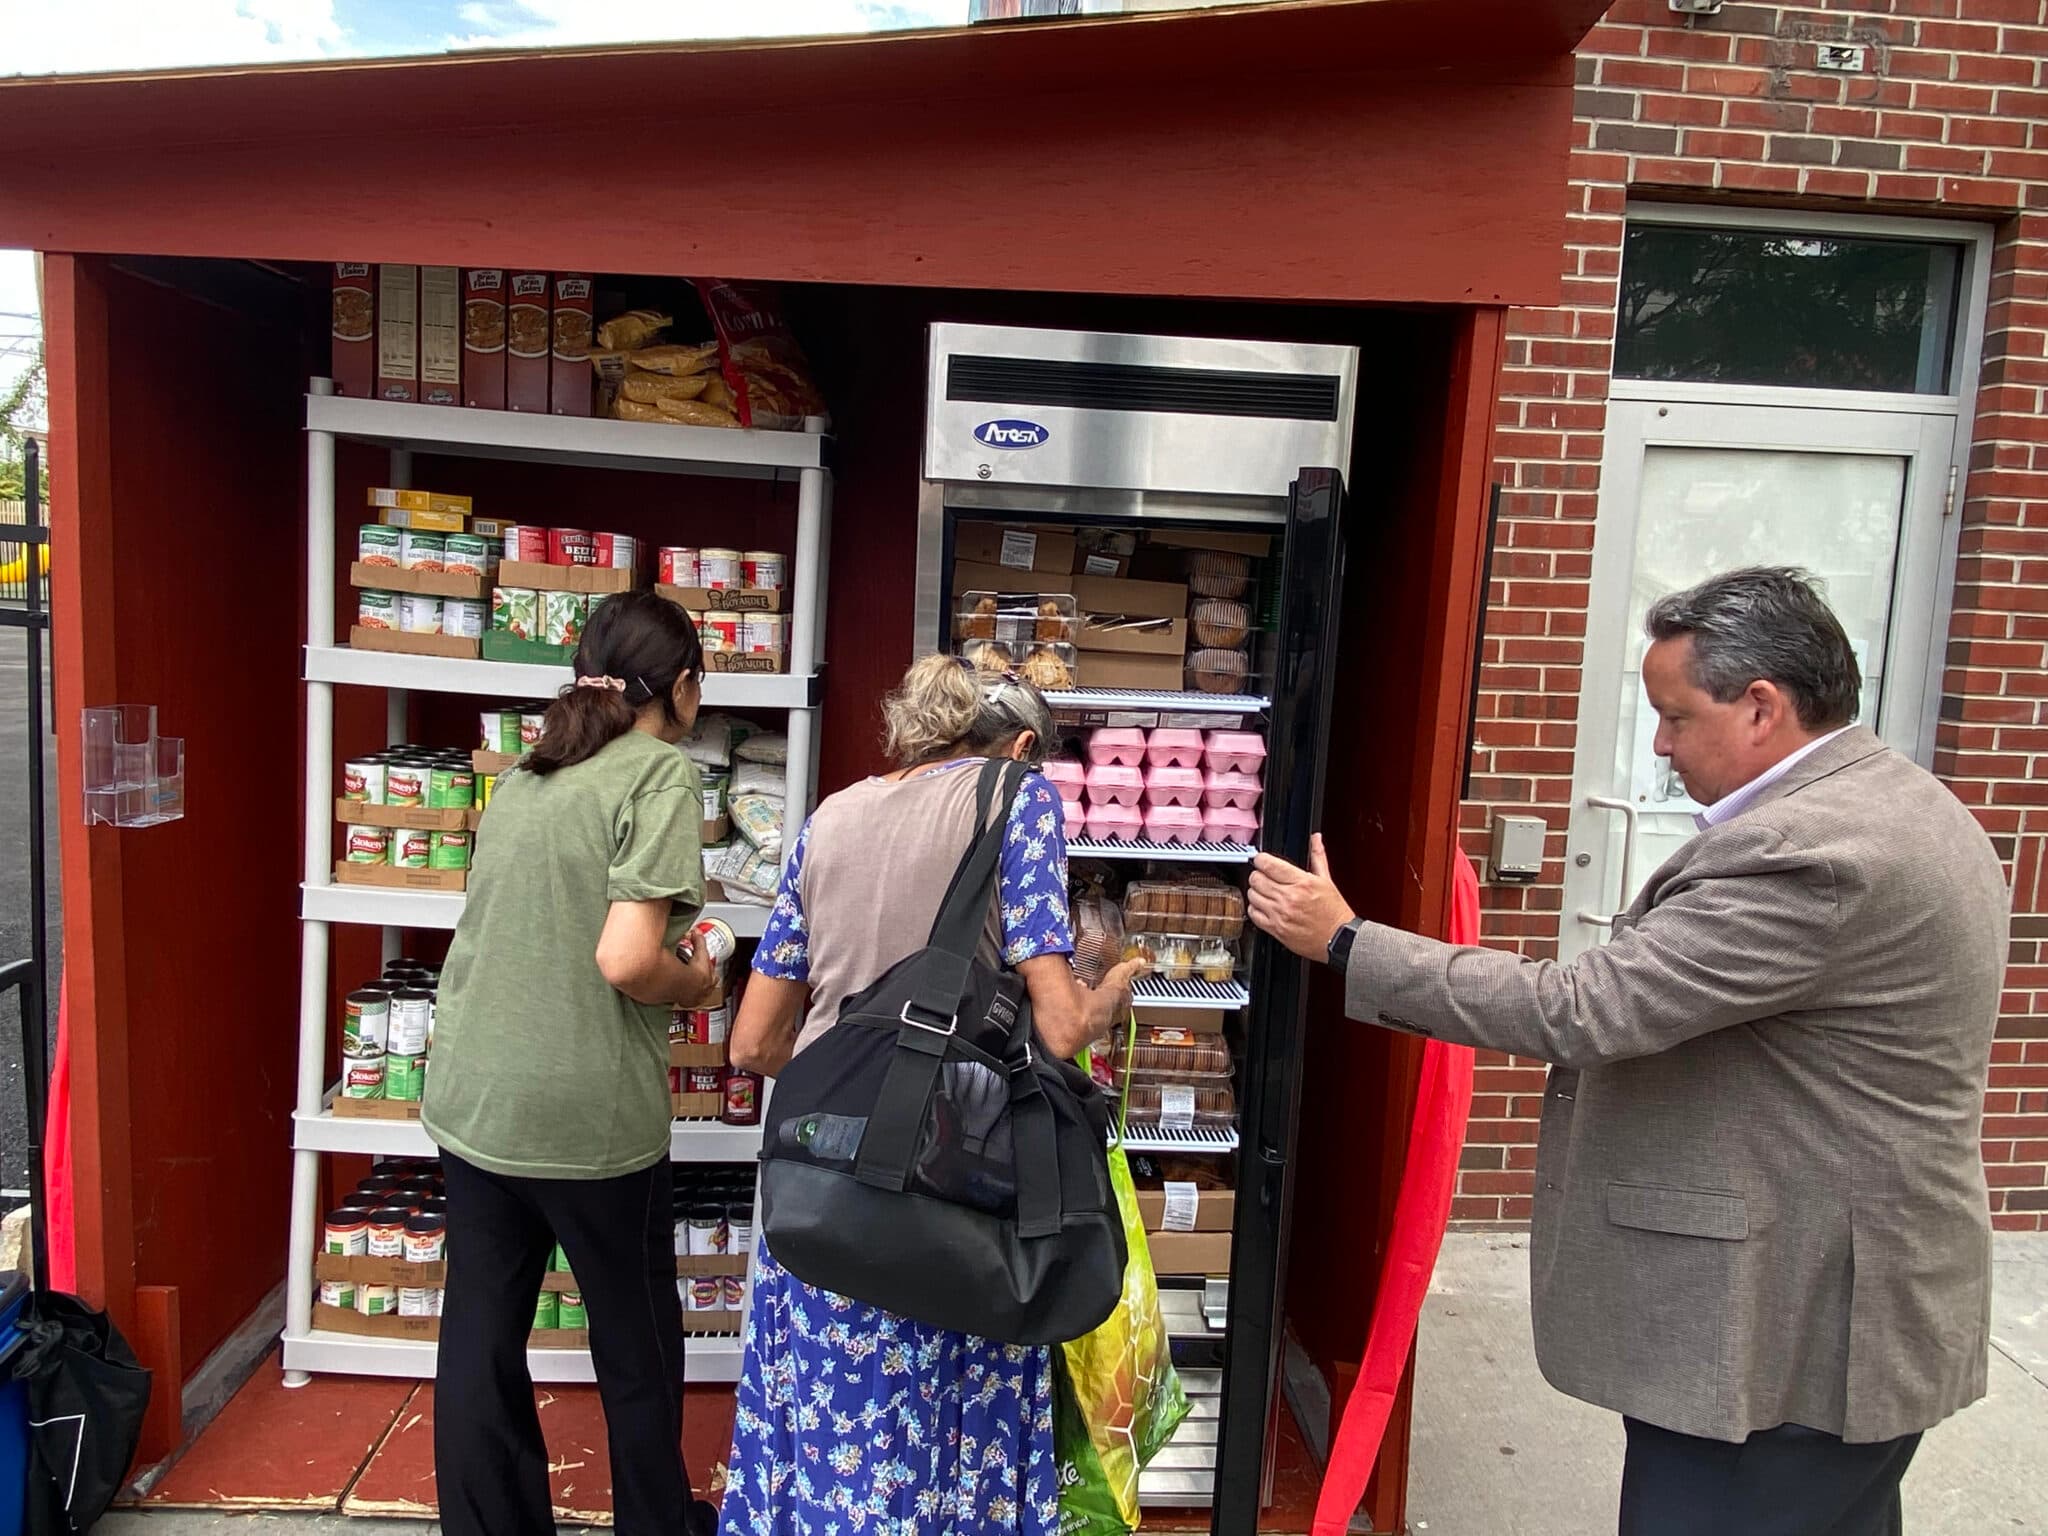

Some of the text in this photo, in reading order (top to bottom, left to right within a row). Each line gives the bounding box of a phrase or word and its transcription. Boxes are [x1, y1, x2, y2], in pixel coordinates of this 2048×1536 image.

[983, 422, 1040, 443] ATOSA
[722, 595, 769, 610] BOYARDEE
[727, 658, 773, 672] BOYARDEE
